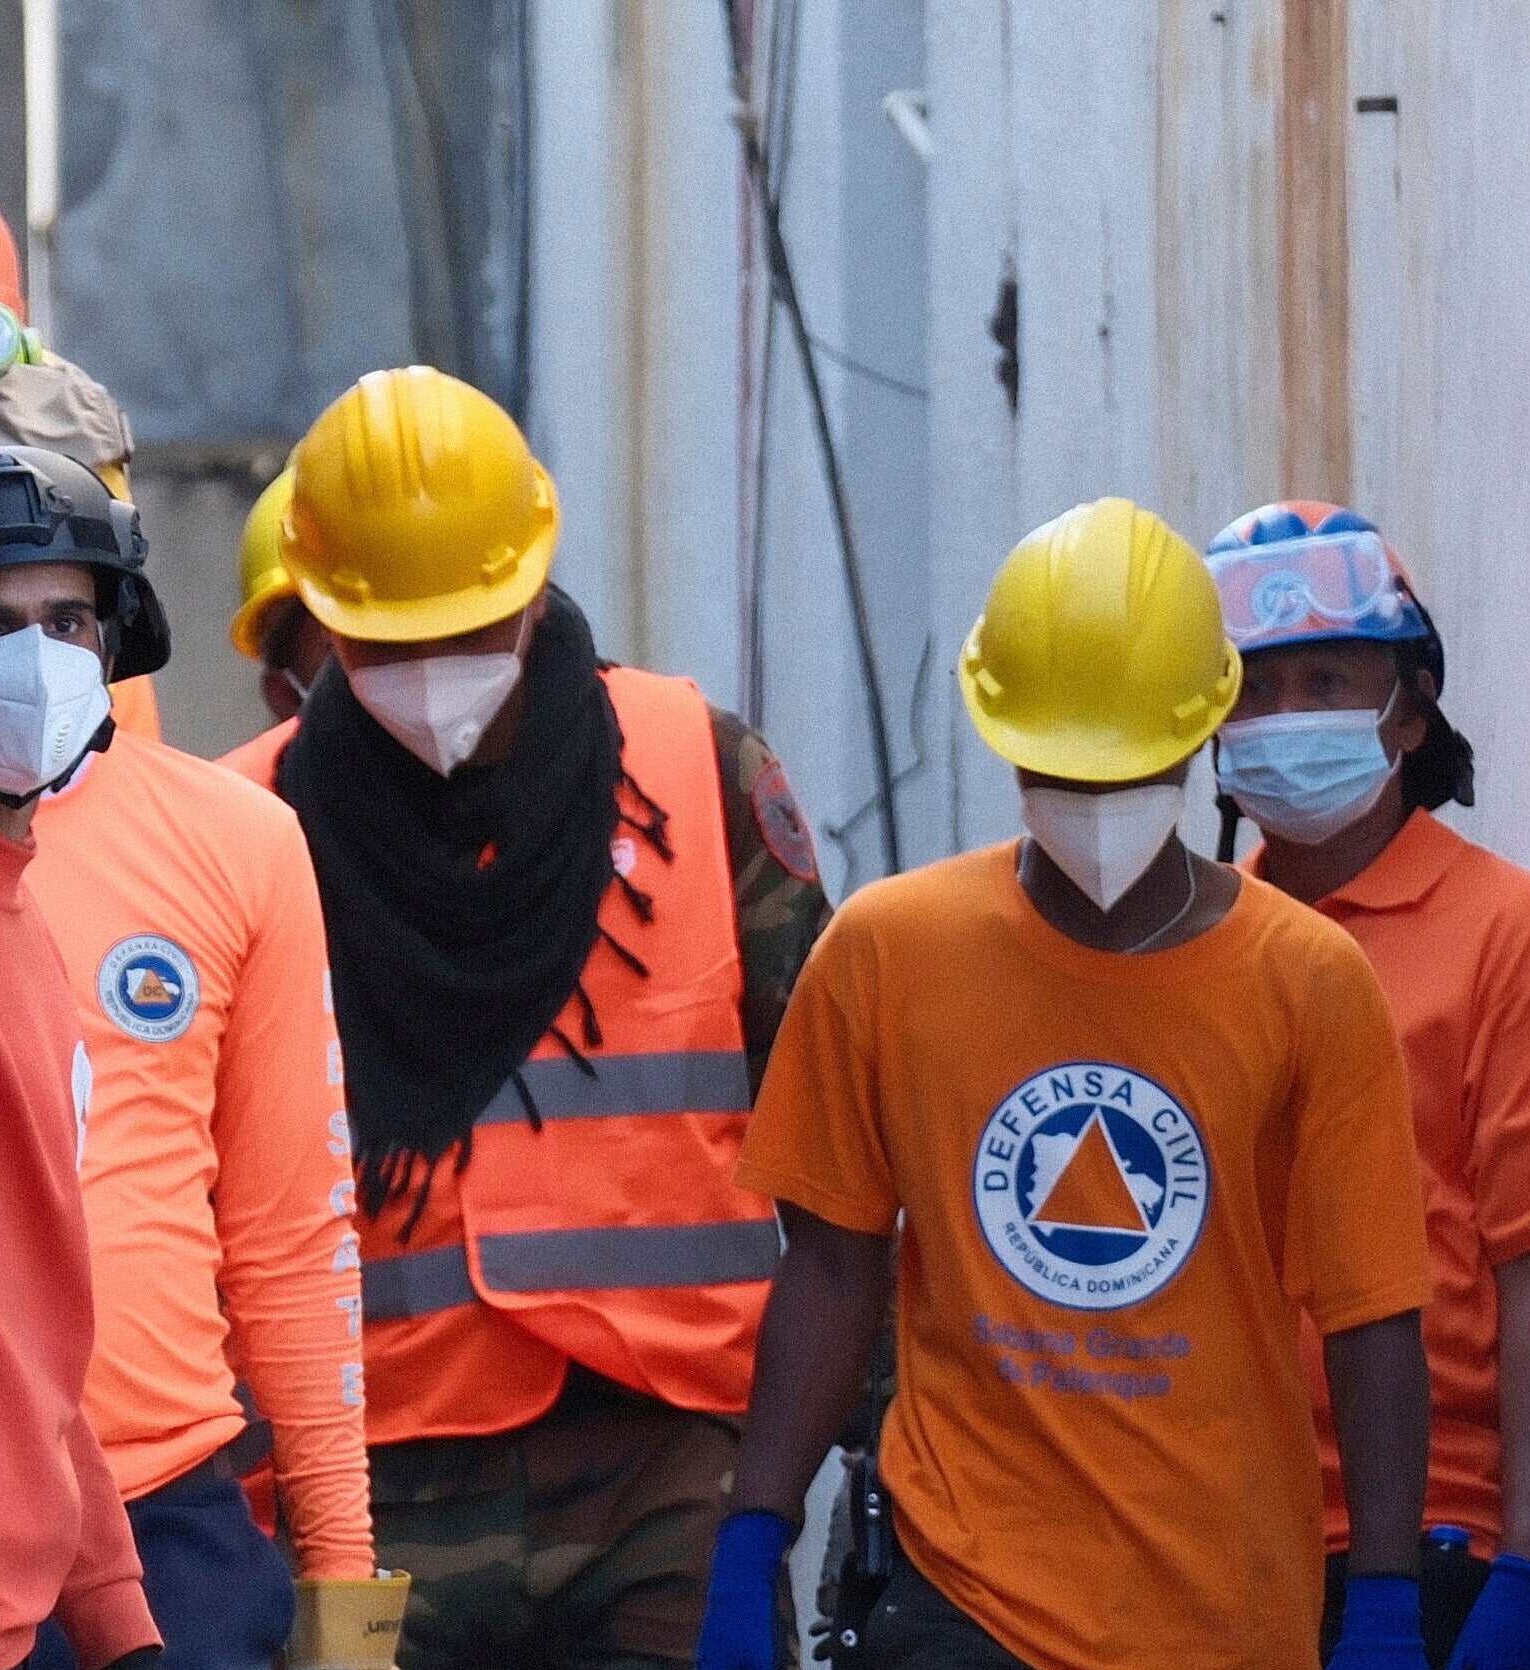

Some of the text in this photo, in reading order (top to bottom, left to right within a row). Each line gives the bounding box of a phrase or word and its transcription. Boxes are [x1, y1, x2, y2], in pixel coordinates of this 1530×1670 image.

[983, 1070, 1200, 1209] DEFENSA CIVIL
[1086, 1237, 1179, 1293] DOMINICANA
